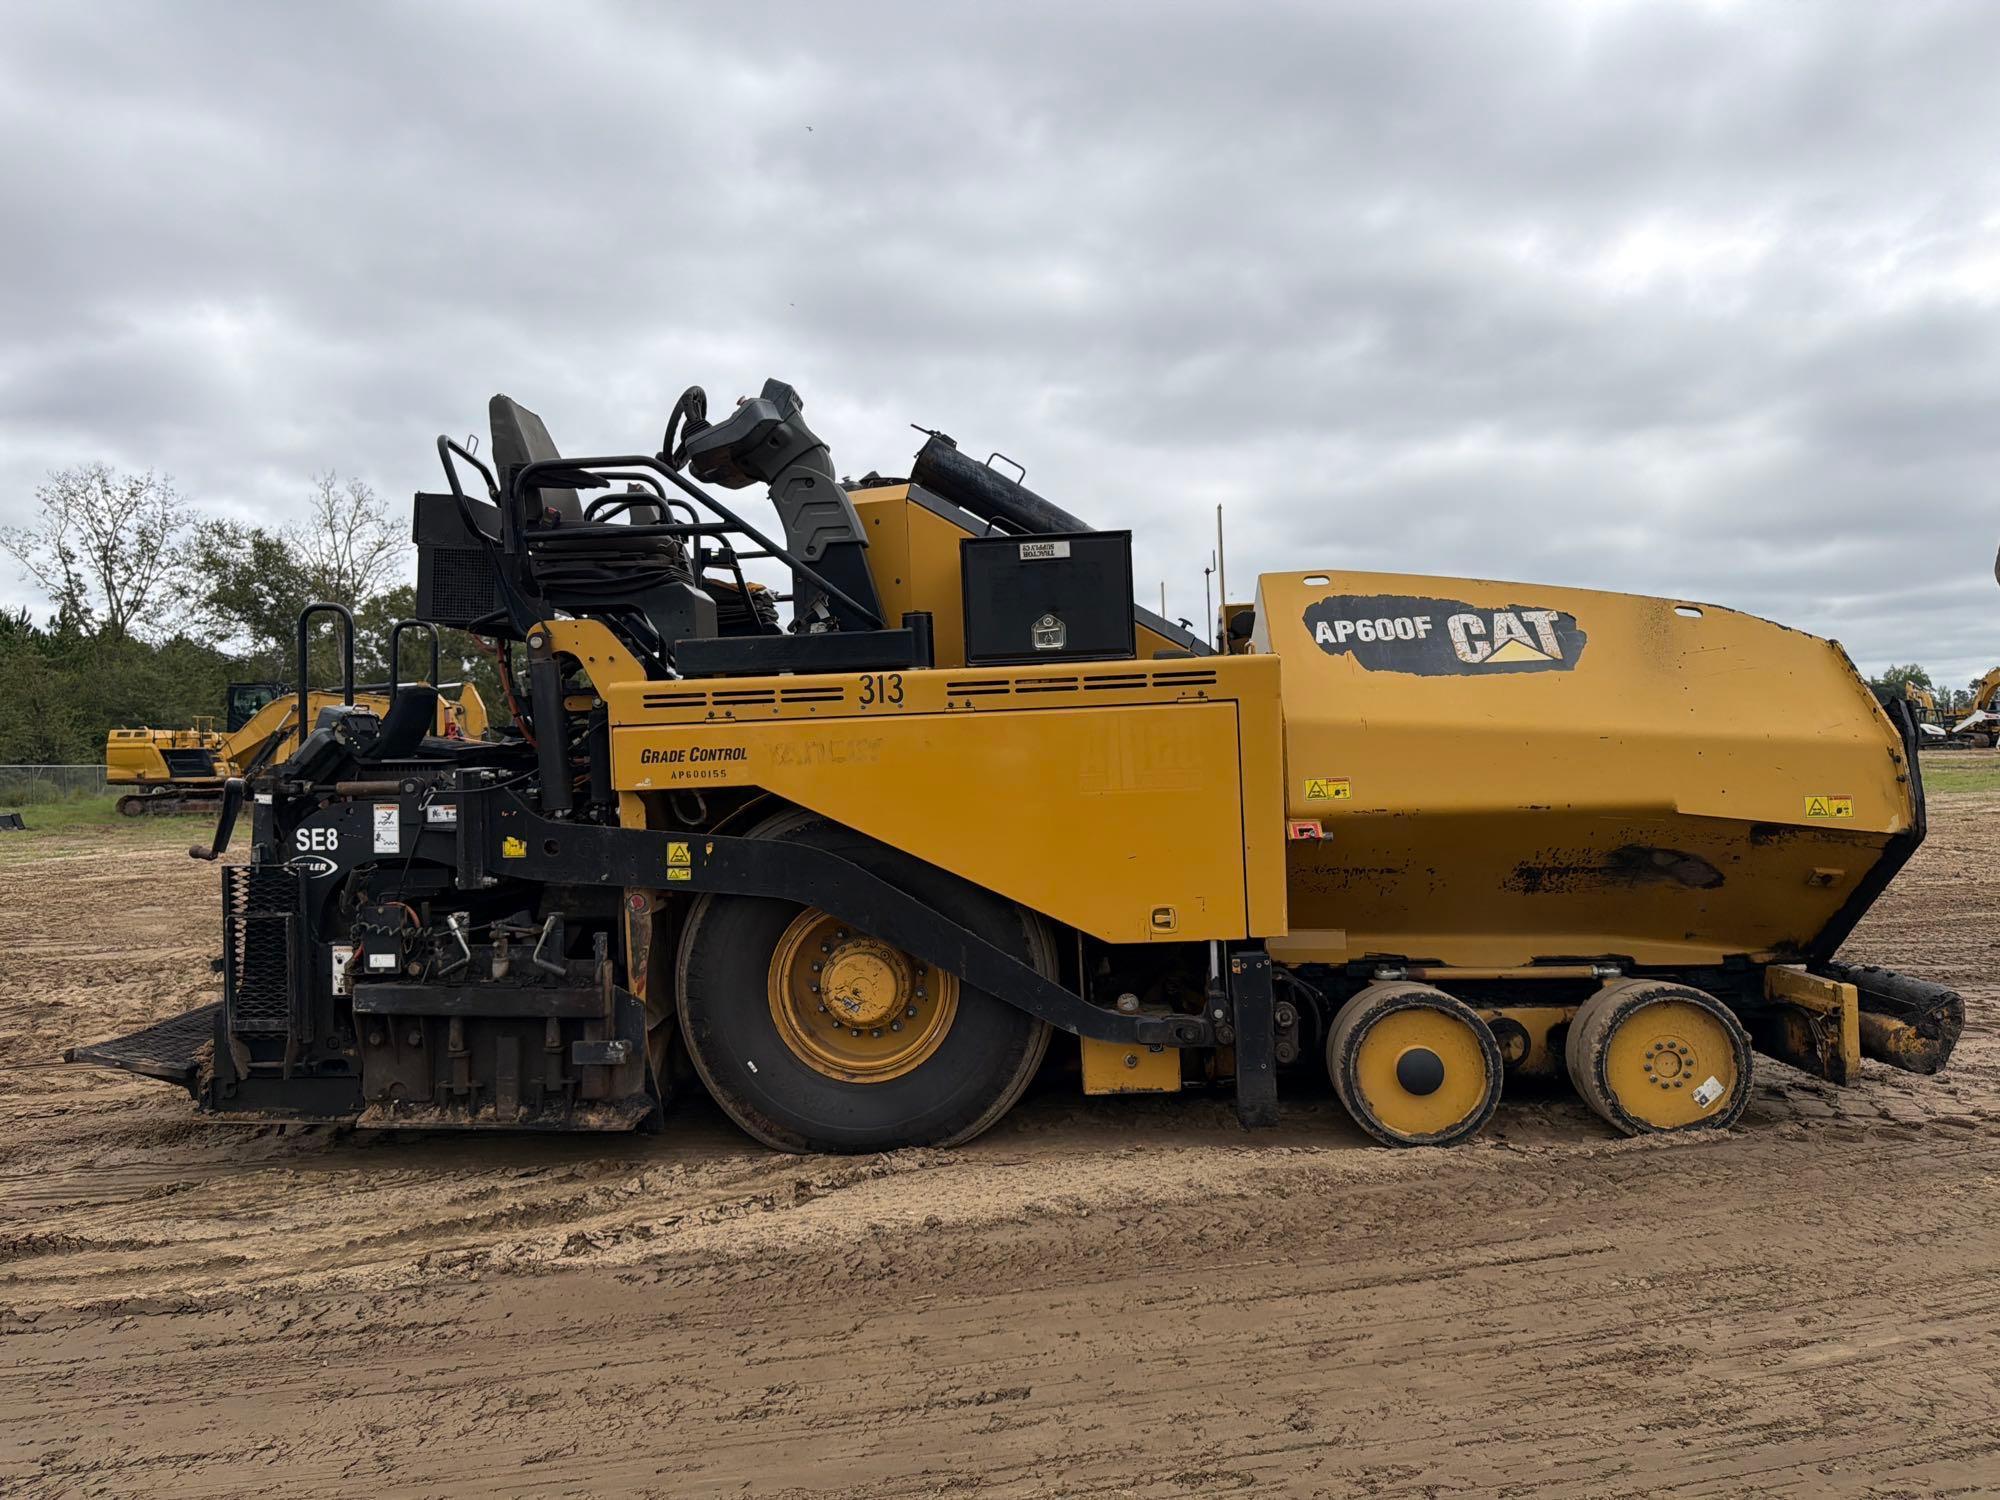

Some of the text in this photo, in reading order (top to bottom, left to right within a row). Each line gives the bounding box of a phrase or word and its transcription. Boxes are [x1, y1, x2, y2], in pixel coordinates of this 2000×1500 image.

[1315, 610, 1564, 664] AP600F CAT
[858, 673, 904, 705] 313
[641, 748, 686, 764] GRADE
[689, 746, 748, 762] CONTROL
[671, 769, 727, 780] AP600155
[295, 827, 339, 851] SE8
